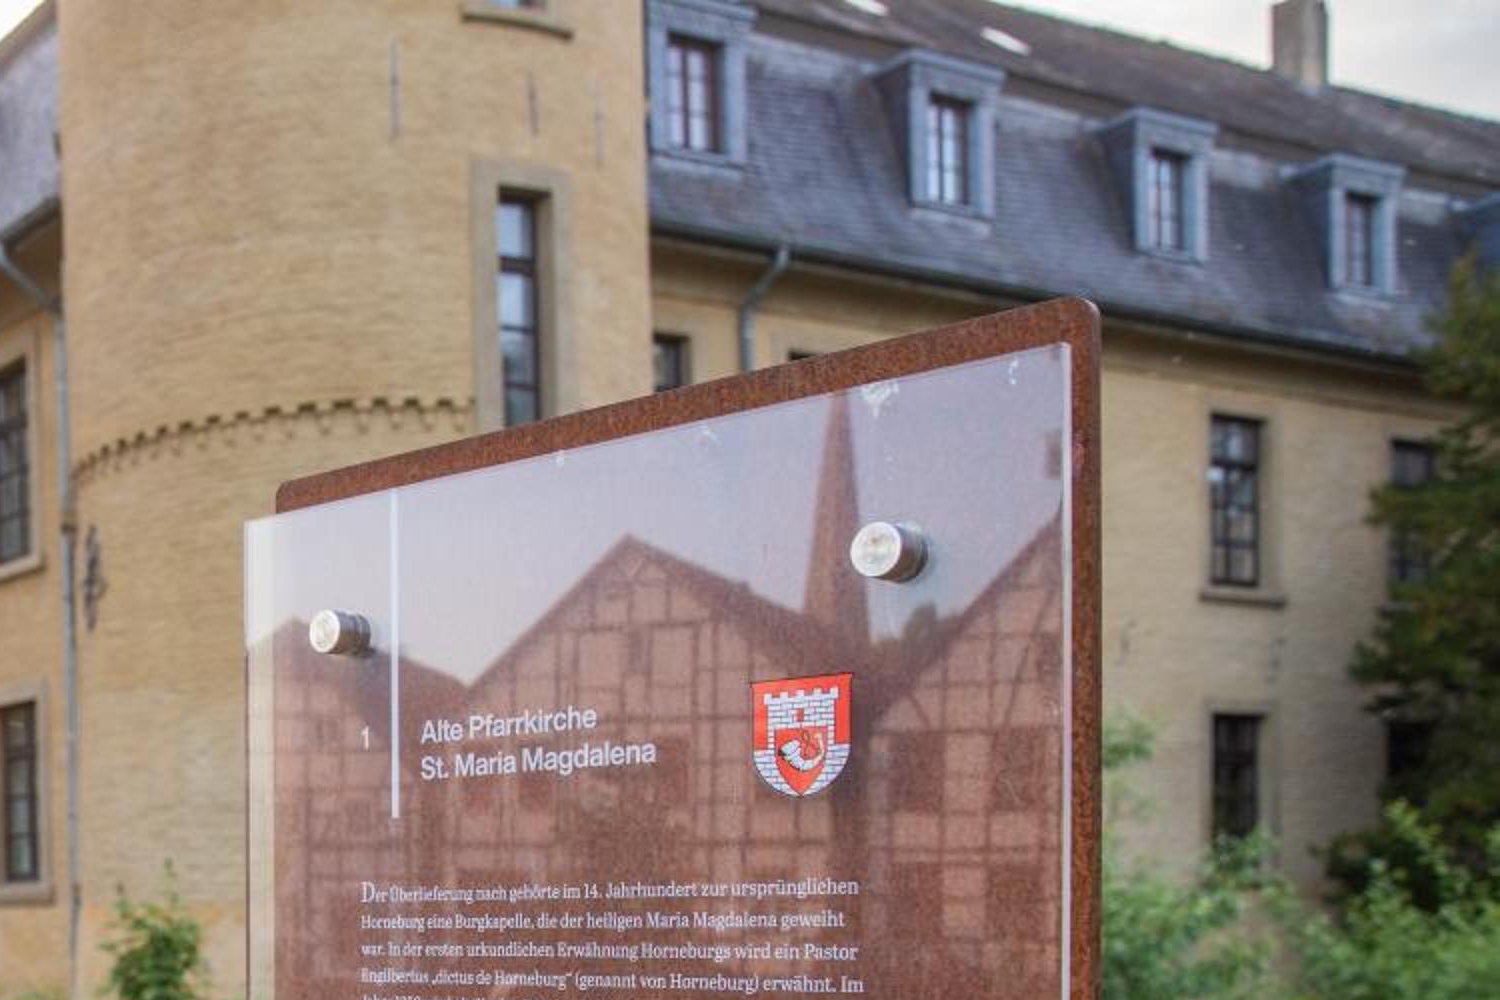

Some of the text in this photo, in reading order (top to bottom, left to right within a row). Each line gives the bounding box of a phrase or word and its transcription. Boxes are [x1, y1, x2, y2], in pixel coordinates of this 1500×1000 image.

[420, 706, 598, 744] Alte Pfarrkirche
[362, 728, 370, 750] 1
[420, 744, 656, 780] St. Maria Magdalena
[362, 881, 388, 901] Der
[476, 883, 506, 900] nach
[509, 882, 559, 904] gehörte
[563, 882, 580, 899] im
[584, 882, 602, 898] 14.
[606, 880, 700, 898] Jahrhundert
[702, 884, 730, 897] zur
[731, 878, 859, 901] ursprünglichen
[361, 914, 425, 932] Horneburg
[427, 914, 454, 928] eine
[537, 913, 558, 928] die
[560, 913, 582, 928] der
[586, 912, 643, 932] heiligen
[646, 912, 690, 928] Maria
[692, 911, 777, 932] Magdalena
[781, 910, 845, 932] geweiht
[388, 942, 400, 956] In
[401, 942, 422, 956] der
[425, 942, 463, 957] ersten
[466, 942, 554, 958] urkundlichen
[557, 942, 638, 963] Erwähnung
[640, 943, 731, 964] Horneburgs
[734, 943, 770, 959] wird
[774, 943, 800, 960] ein
[804, 943, 858, 960] Pastor
[476, 970, 491, 985] de
[575, 971, 637, 991] (genannt
[640, 977, 666, 989] von
[670, 973, 758, 995] Horneburg)
[762, 975, 836, 992] erwähnt.
